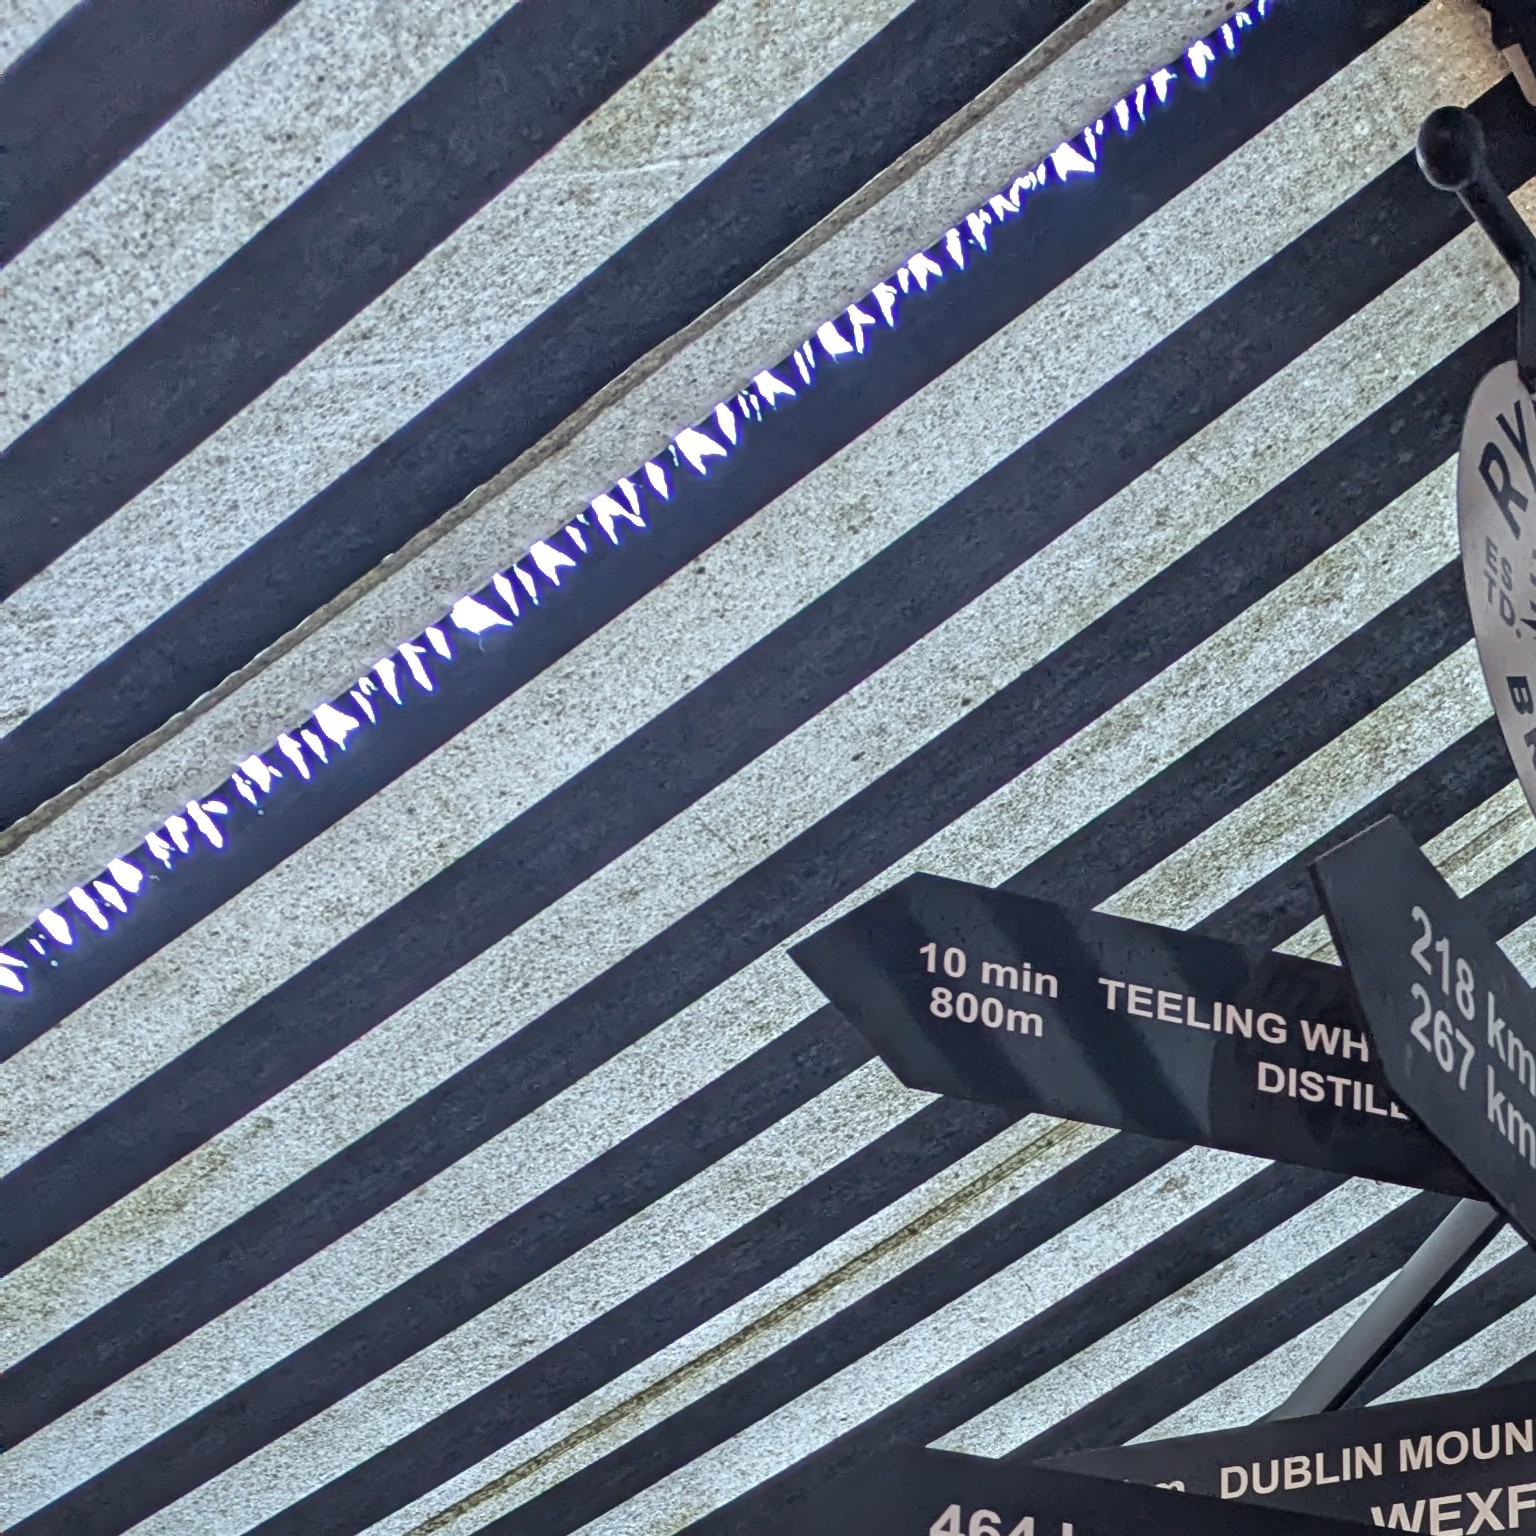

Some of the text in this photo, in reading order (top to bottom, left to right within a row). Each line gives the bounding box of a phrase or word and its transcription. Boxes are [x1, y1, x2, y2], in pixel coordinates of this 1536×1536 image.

[918, 942, 968, 979] 10
[981, 960, 1059, 998] min
[1098, 977, 1287, 1046] TEELING
[930, 987, 1045, 1038] 800m
[1411, 906, 1475, 1021] 218
[1488, 992, 1536, 1097] km
[1409, 983, 1475, 1090] 267
[1487, 1065, 1536, 1170] km
[1219, 1443, 1384, 1501] DUBLIN
